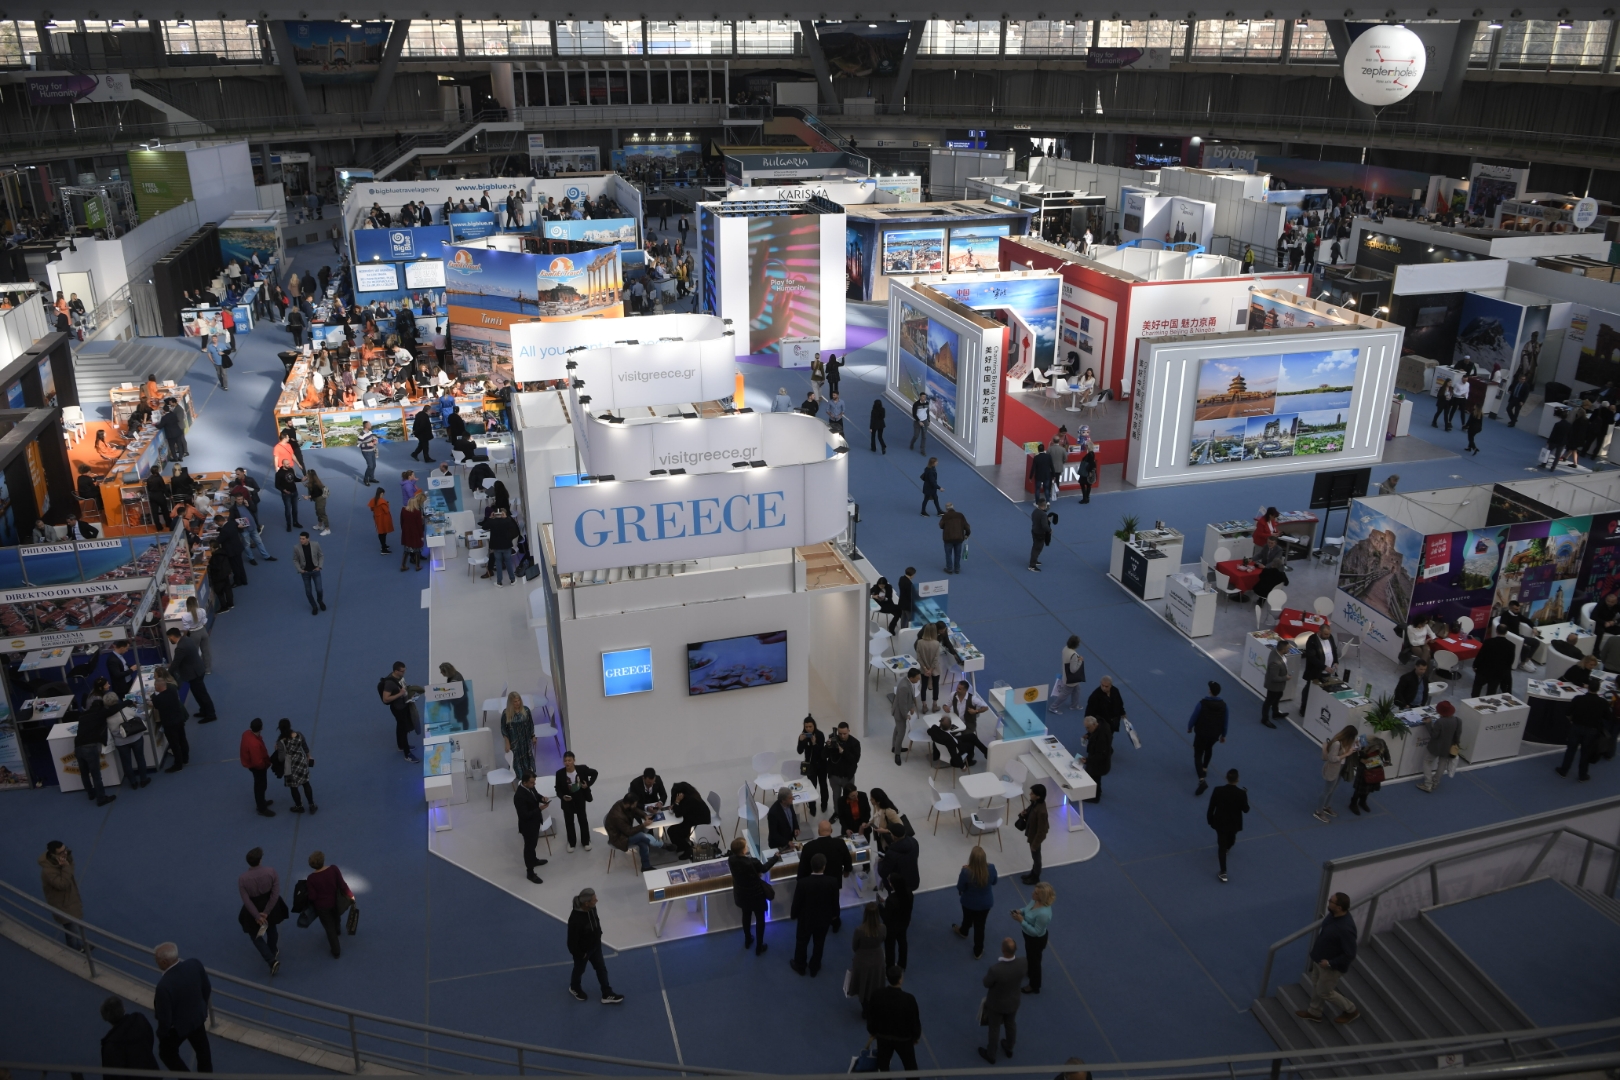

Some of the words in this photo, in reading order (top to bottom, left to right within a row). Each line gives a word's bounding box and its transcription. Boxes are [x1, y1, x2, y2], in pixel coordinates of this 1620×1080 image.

[1095, 57, 1125, 66] Humanity
[31, 83, 49, 93] Play
[39, 89, 78, 100] Humanity
[1213, 145, 1256, 162] Будва
[763, 157, 808, 167] BULGARIA
[455, 183, 516, 191] www.bigblue.rs
[778, 189, 830, 200] KARISMA
[453, 220, 494, 228] www.bigblue.rs
[564, 267, 582, 276] Travel
[481, 312, 502, 326] Tunis
[1143, 319, 1178, 331] 美好中国
[1181, 316, 1217, 328] 魅力京甬
[1142, 328, 1168, 337] Charming
[1170, 327, 1188, 336] Beijing
[1194, 326, 1216, 334] Ningbo
[519, 345, 537, 358] All
[540, 346, 565, 360] you
[984, 346, 993, 383] 美好中国
[991, 346, 1000, 375] Charming
[618, 366, 696, 384] visitgreece.gr
[990, 375, 998, 395] Beijing
[989, 401, 997, 423] Ningbo
[659, 446, 758, 467] visitgreece.gr
[574, 491, 787, 549] GREECE
[22, 545, 73, 555] PHILOXENIA
[79, 540, 121, 550] BOUTIQUE
[5, 591, 54, 602] DIREKTNO
[56, 589, 70, 597] OD
[71, 584, 119, 596] VLASNIKA
[40, 632, 84, 641] PHILOXENIA
[605, 664, 652, 679] GREECE
[1485, 722, 1520, 731] COURTYARD
